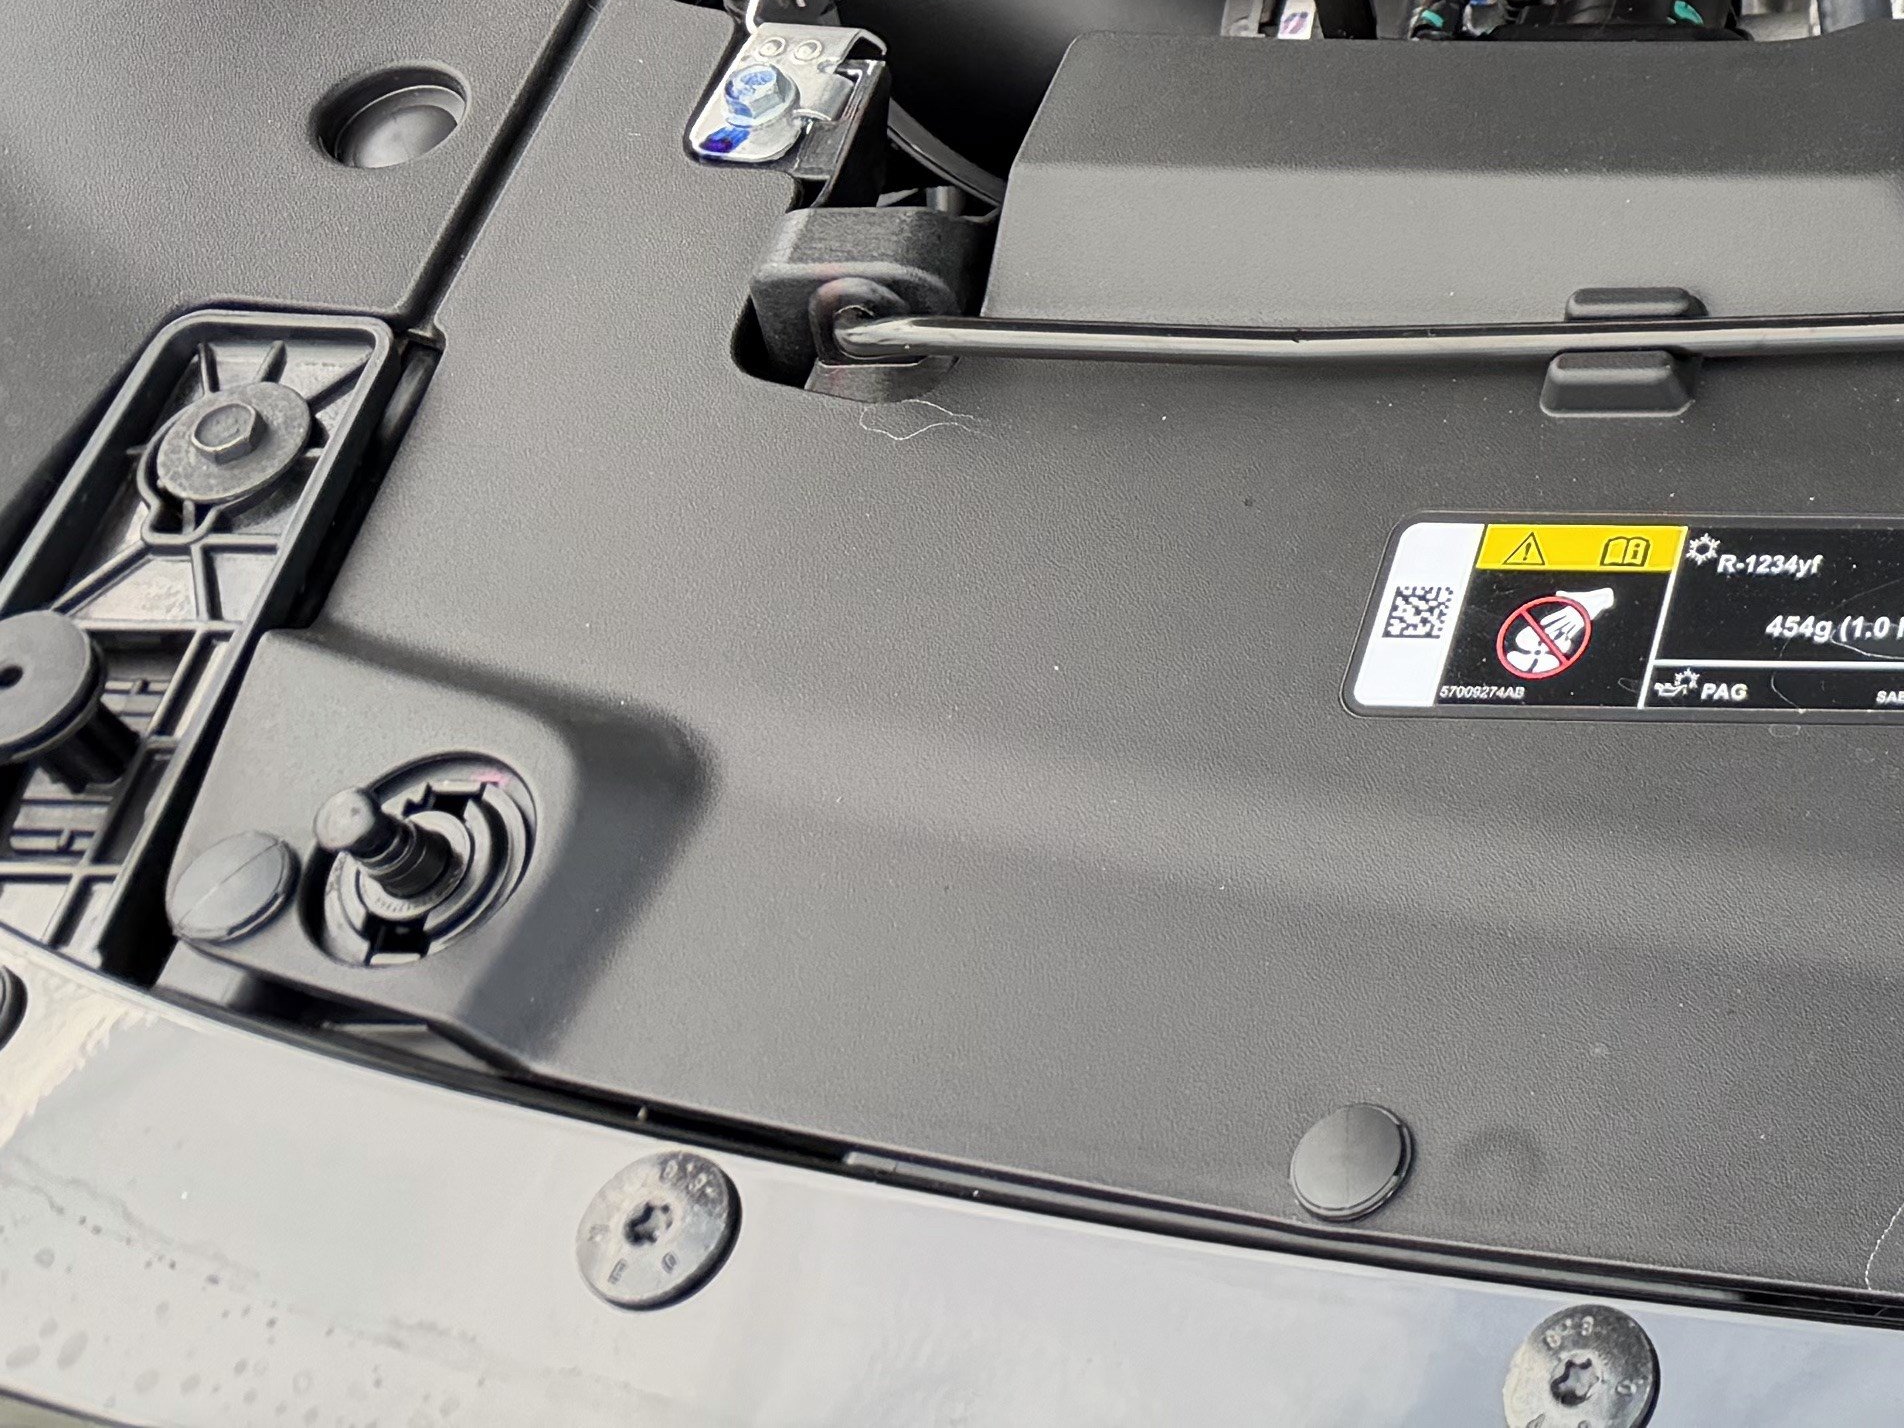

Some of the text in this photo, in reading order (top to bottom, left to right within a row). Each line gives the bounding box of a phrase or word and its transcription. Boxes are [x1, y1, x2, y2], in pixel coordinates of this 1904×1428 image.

[1717, 554, 1824, 580] R-1234yf
[1765, 615, 1833, 643] 454g
[1840, 615, 1891, 643] (1.0
[1439, 684, 1526, 700] 57009274AB
[1700, 682, 1748, 701] PAG
